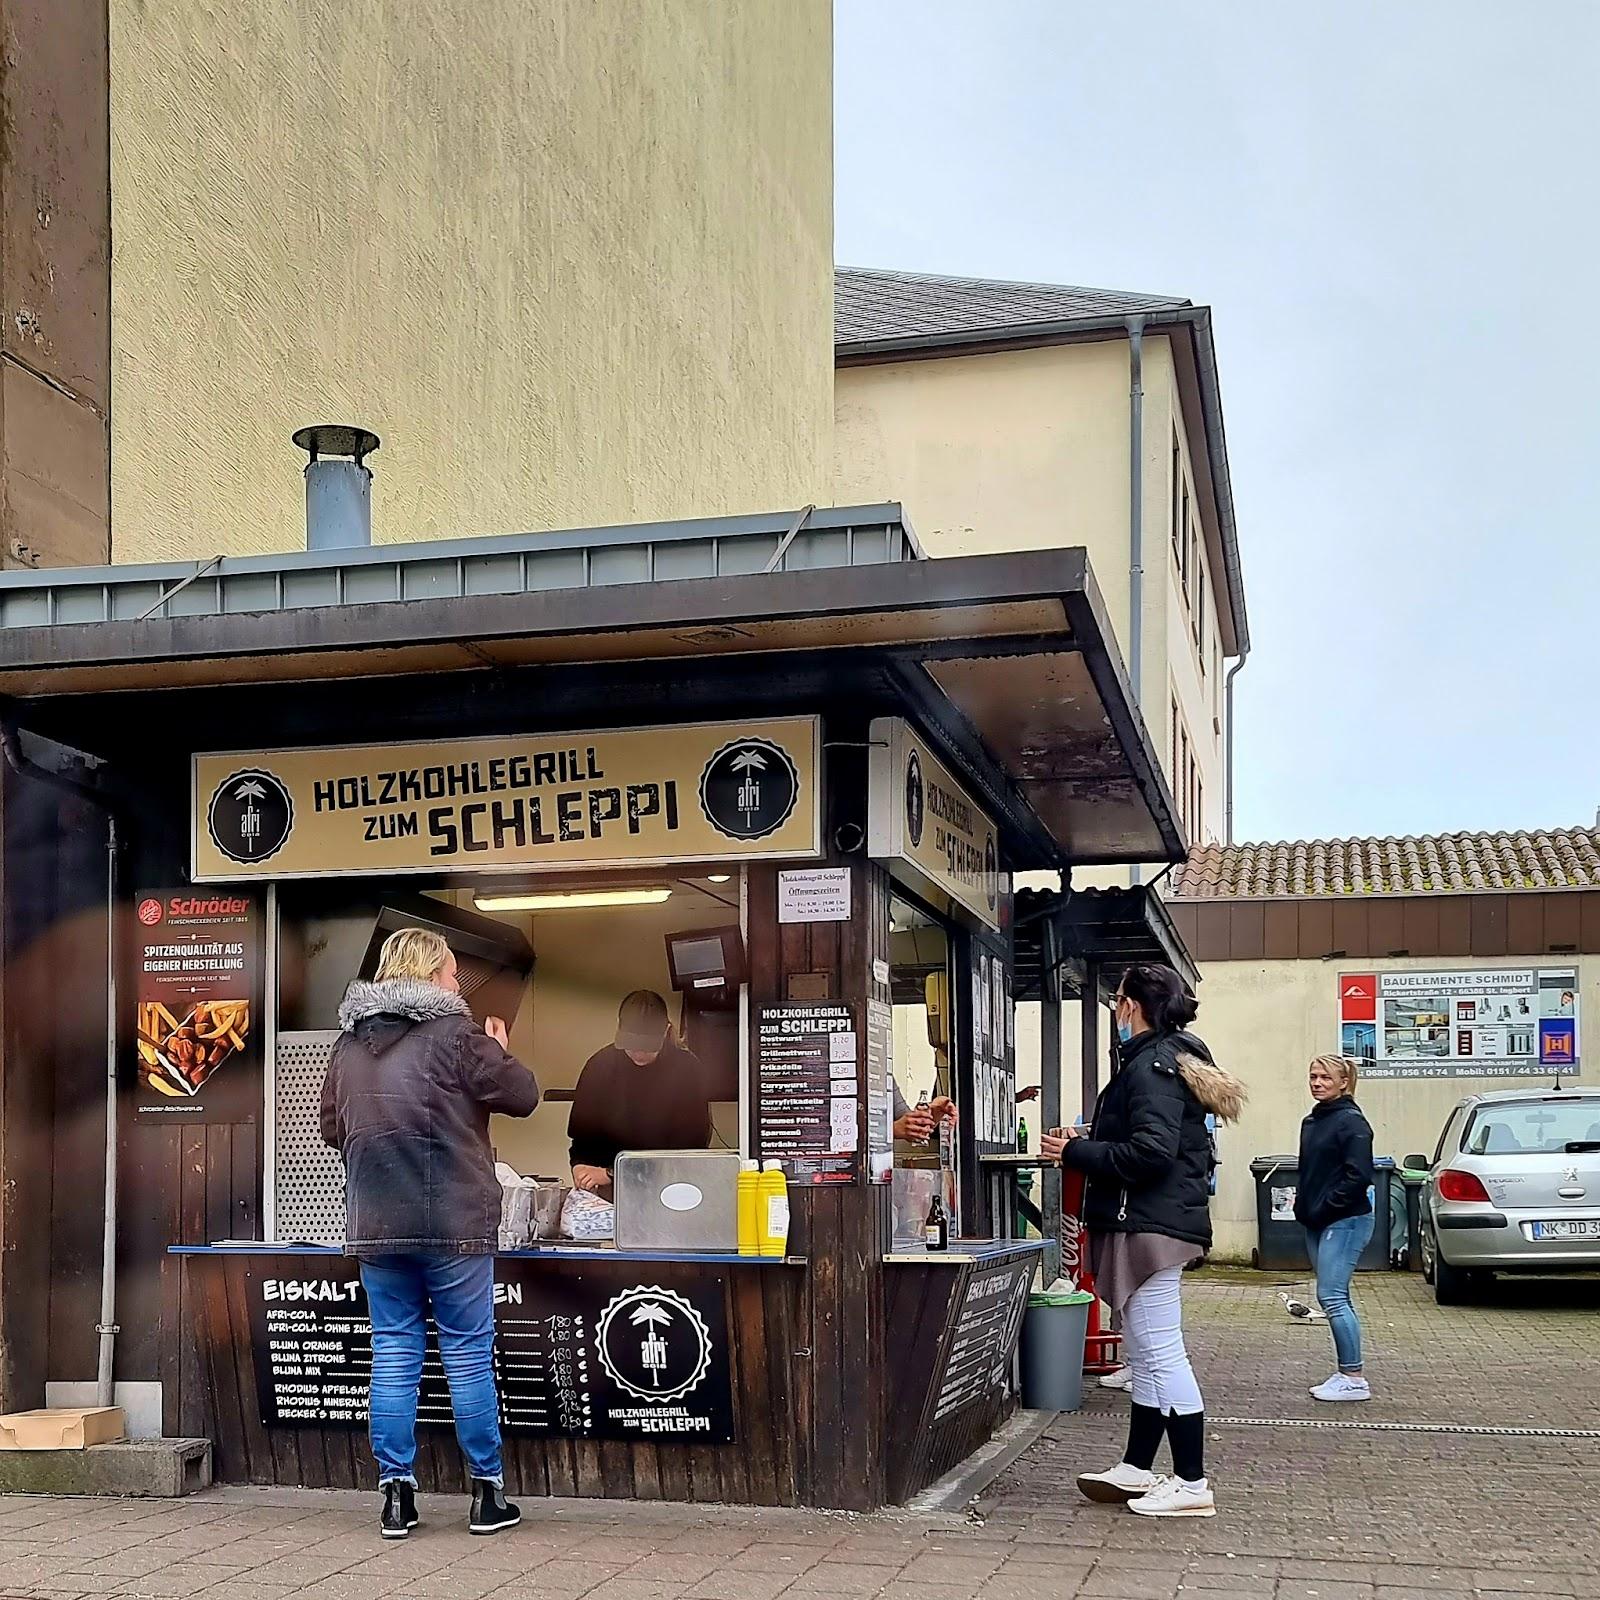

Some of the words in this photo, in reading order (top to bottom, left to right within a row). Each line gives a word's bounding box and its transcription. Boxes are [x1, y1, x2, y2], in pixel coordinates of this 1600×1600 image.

[314, 747, 604, 812] HOLZKOHLEGRILL
[738, 777, 760, 807] afri
[241, 805, 260, 833] afri
[363, 811, 418, 841] ZUM
[428, 780, 679, 856] SCHLEPPI
[788, 886, 840, 897] Öffnungszeiten
[169, 897, 249, 915] Schröder
[144, 942, 224, 957] SPITZENQUALITÄT
[225, 943, 243, 955] AUS
[143, 960, 181, 972] EIGENER
[182, 958, 243, 970] HERSTELLUNG
[1383, 976, 1471, 986] BAUELEMENTE
[1476, 974, 1531, 984] SCHMIDT
[762, 1007, 850, 1019] HOLZKOHLEGRILL
[760, 1025, 779, 1034] ZUM
[781, 1019, 852, 1034] SCHLEPPI
[1456, 1068, 1485, 1076] Mobil:
[760, 1082, 808, 1090] Currywurst
[760, 1098, 824, 1106] Curryfrikadelle
[760, 1129, 801, 1137] Sparmenü
[1541, 1222, 1559, 1235] NK
[1568, 1222, 1586, 1234] DD
[263, 1279, 360, 1301] EISKALT
[266, 1310, 316, 1320] AFRI-COLA
[324, 1323, 350, 1333] OHNE
[353, 1323, 372, 1333] ZUC
[270, 1341, 299, 1351] BLUNA
[302, 1341, 343, 1351] ORANGE
[641, 1332, 668, 1364] afri
[271, 1353, 301, 1363] BLUNA
[303, 1354, 346, 1364] ZITRONE
[272, 1366, 302, 1376] BLUNA
[305, 1366, 321, 1376] MIX
[274, 1384, 319, 1394] RHODIUS
[321, 1385, 370, 1395] APFELSAF
[276, 1396, 321, 1406] RHODIUS
[323, 1397, 370, 1408] MINERALW
[608, 1407, 690, 1418] HOLZKOHLEGRILL
[329, 1410, 353, 1420] BIER
[560, 1413, 582, 1431] 2,50
[623, 1419, 639, 1427] ZUM
[641, 1416, 711, 1432] SCHLEPPI
